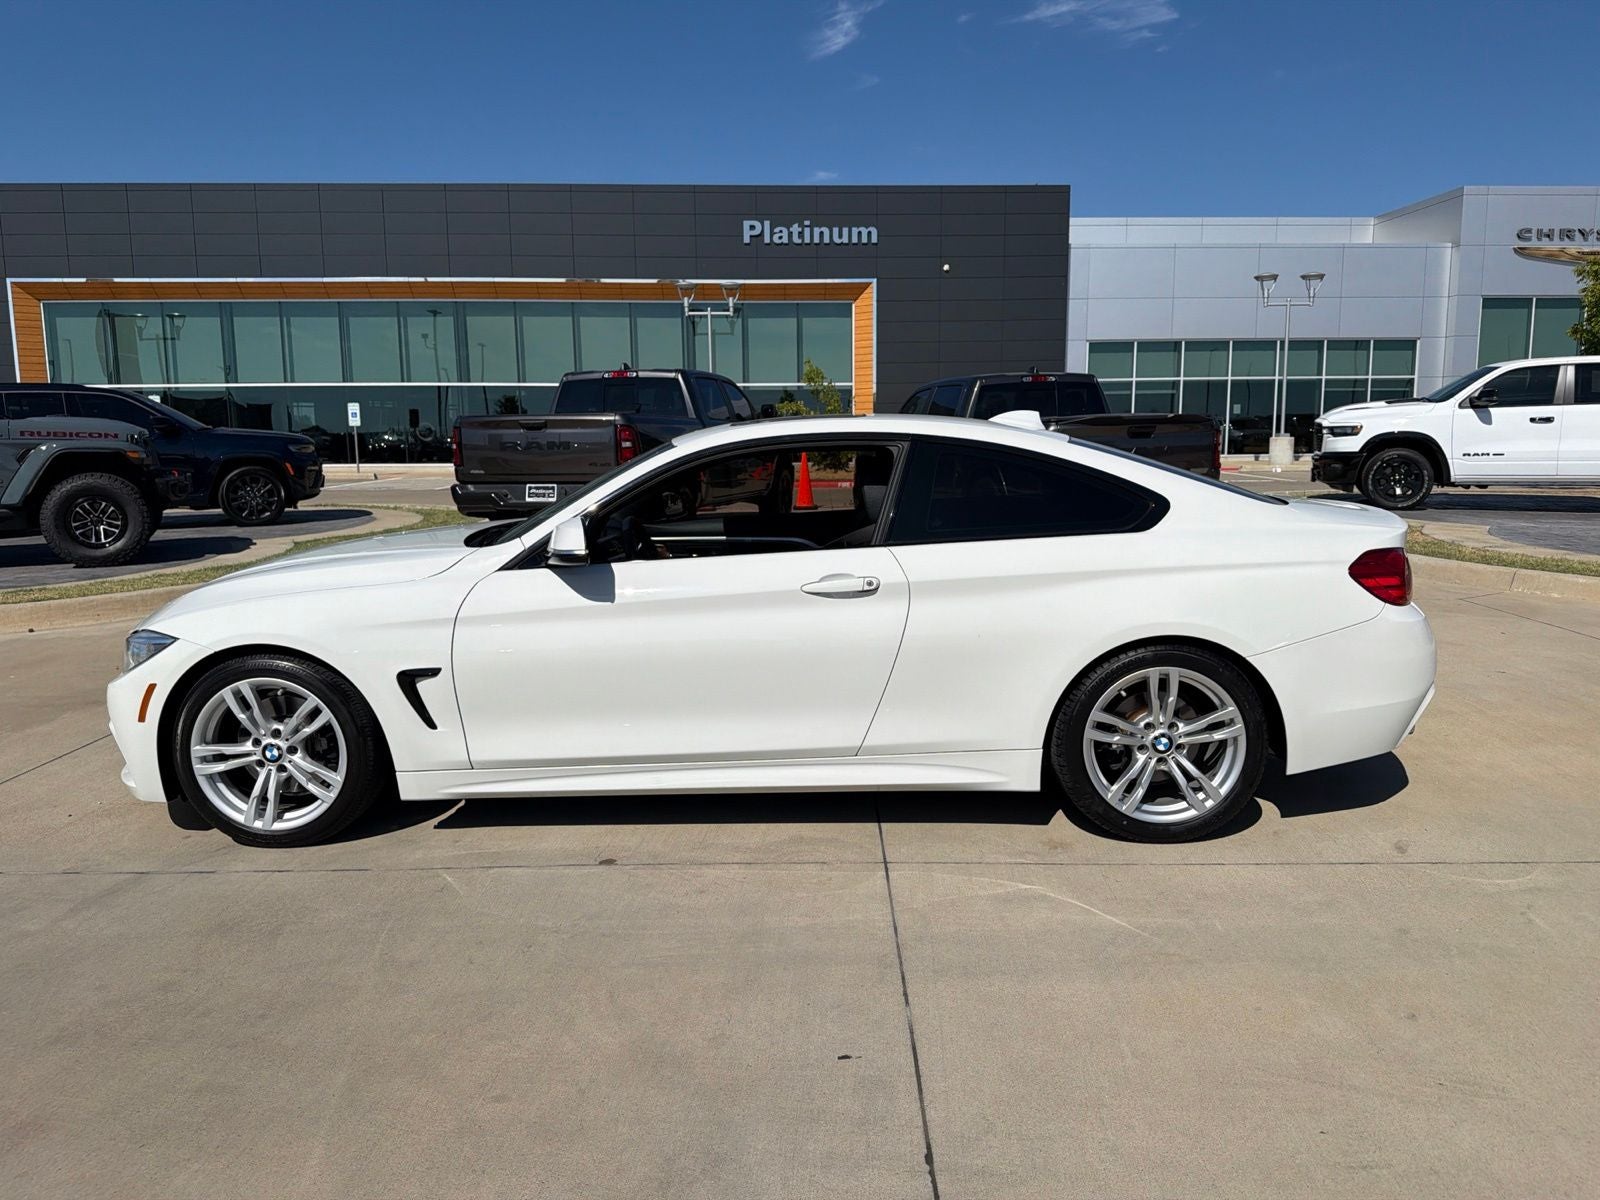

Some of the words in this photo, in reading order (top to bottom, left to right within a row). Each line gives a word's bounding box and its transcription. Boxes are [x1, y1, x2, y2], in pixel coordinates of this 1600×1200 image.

[742, 219, 879, 244] Platinum
[1516, 227, 1600, 242] CHRY
[19, 430, 119, 439] RUBICON
[502, 440, 571, 451] RAM
